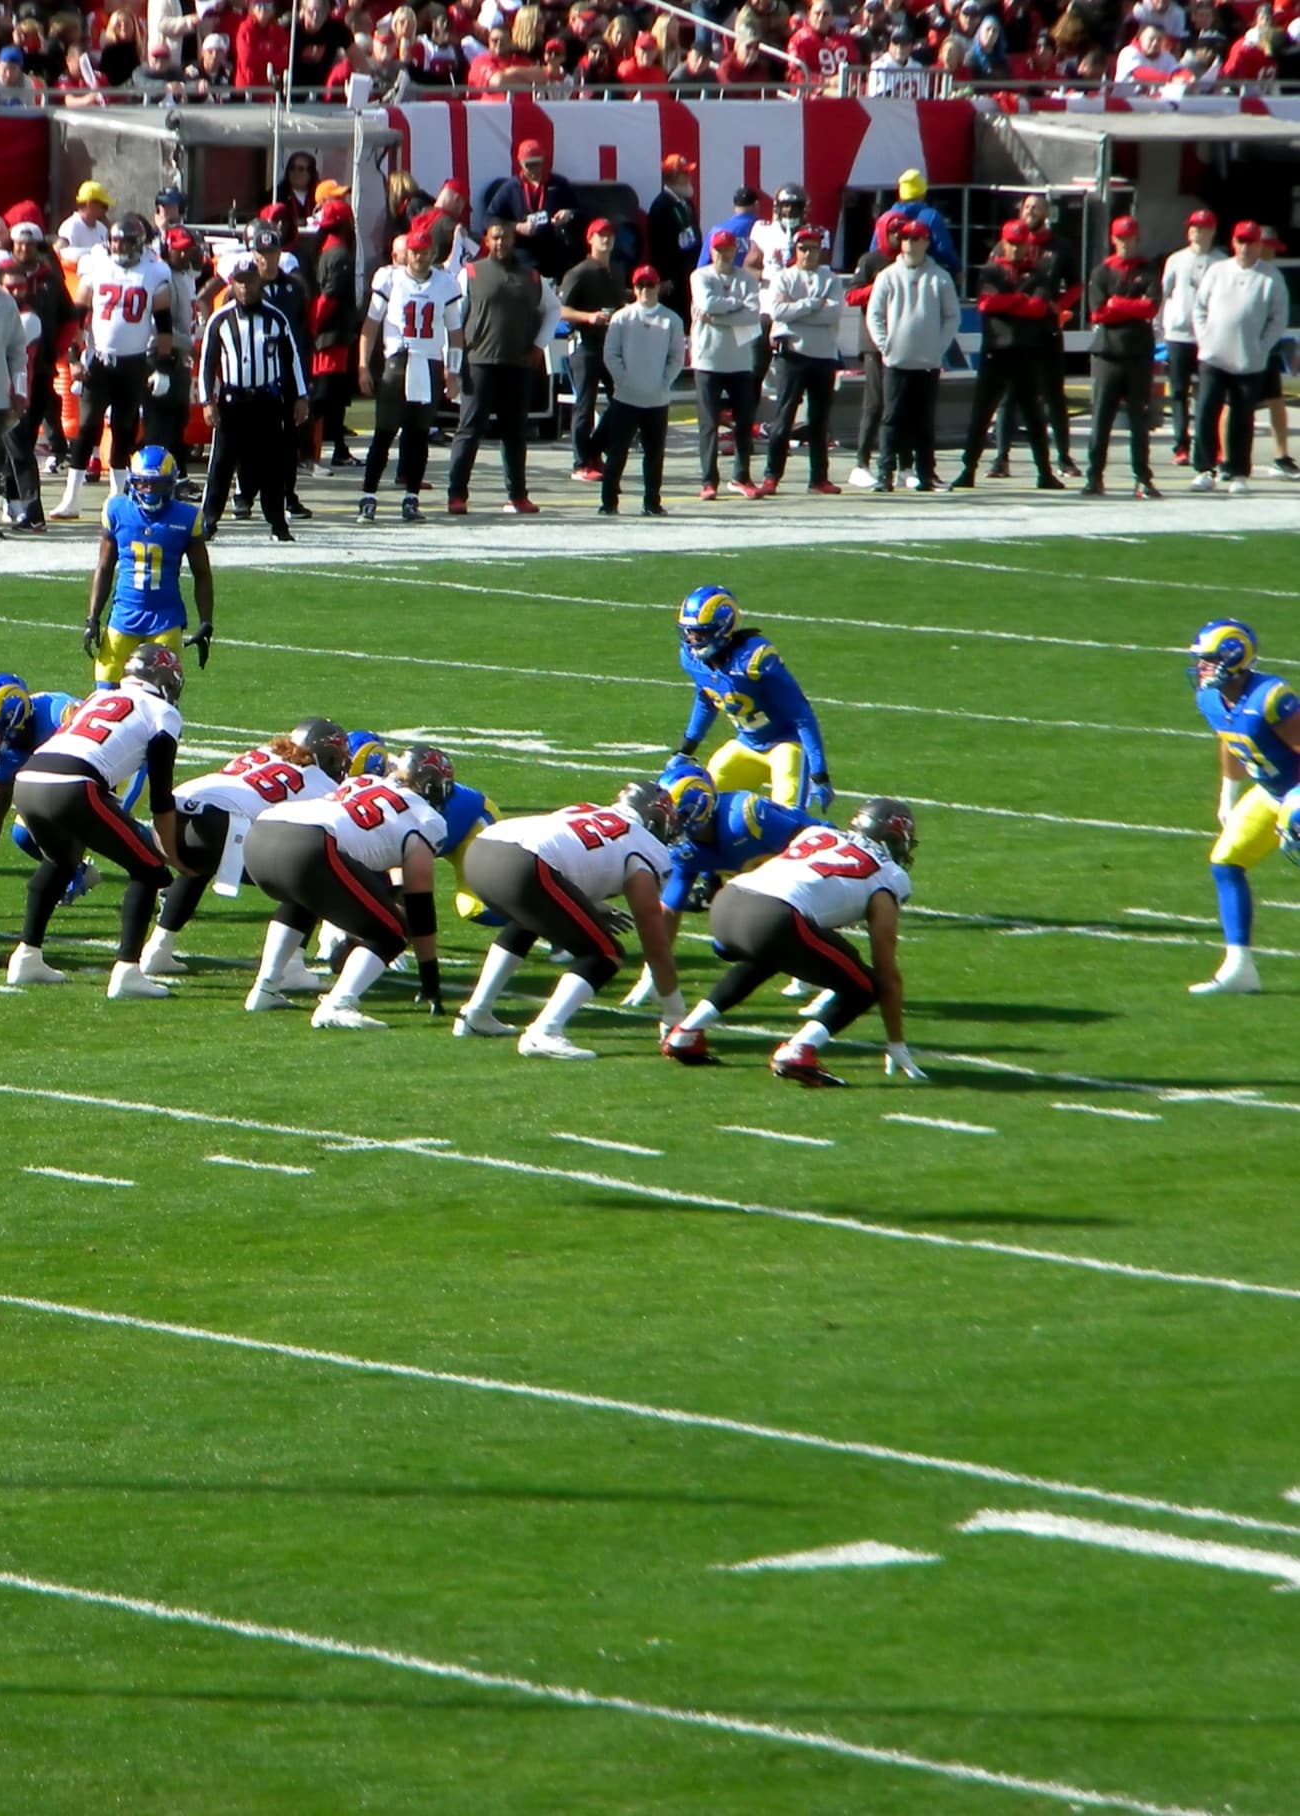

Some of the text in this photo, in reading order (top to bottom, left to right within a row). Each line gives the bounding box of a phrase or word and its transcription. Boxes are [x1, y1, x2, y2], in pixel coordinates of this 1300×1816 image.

[99, 284, 148, 324] 70
[403, 300, 435, 339] 11
[130, 541, 163, 591] 11
[778, 832, 882, 879] 87
